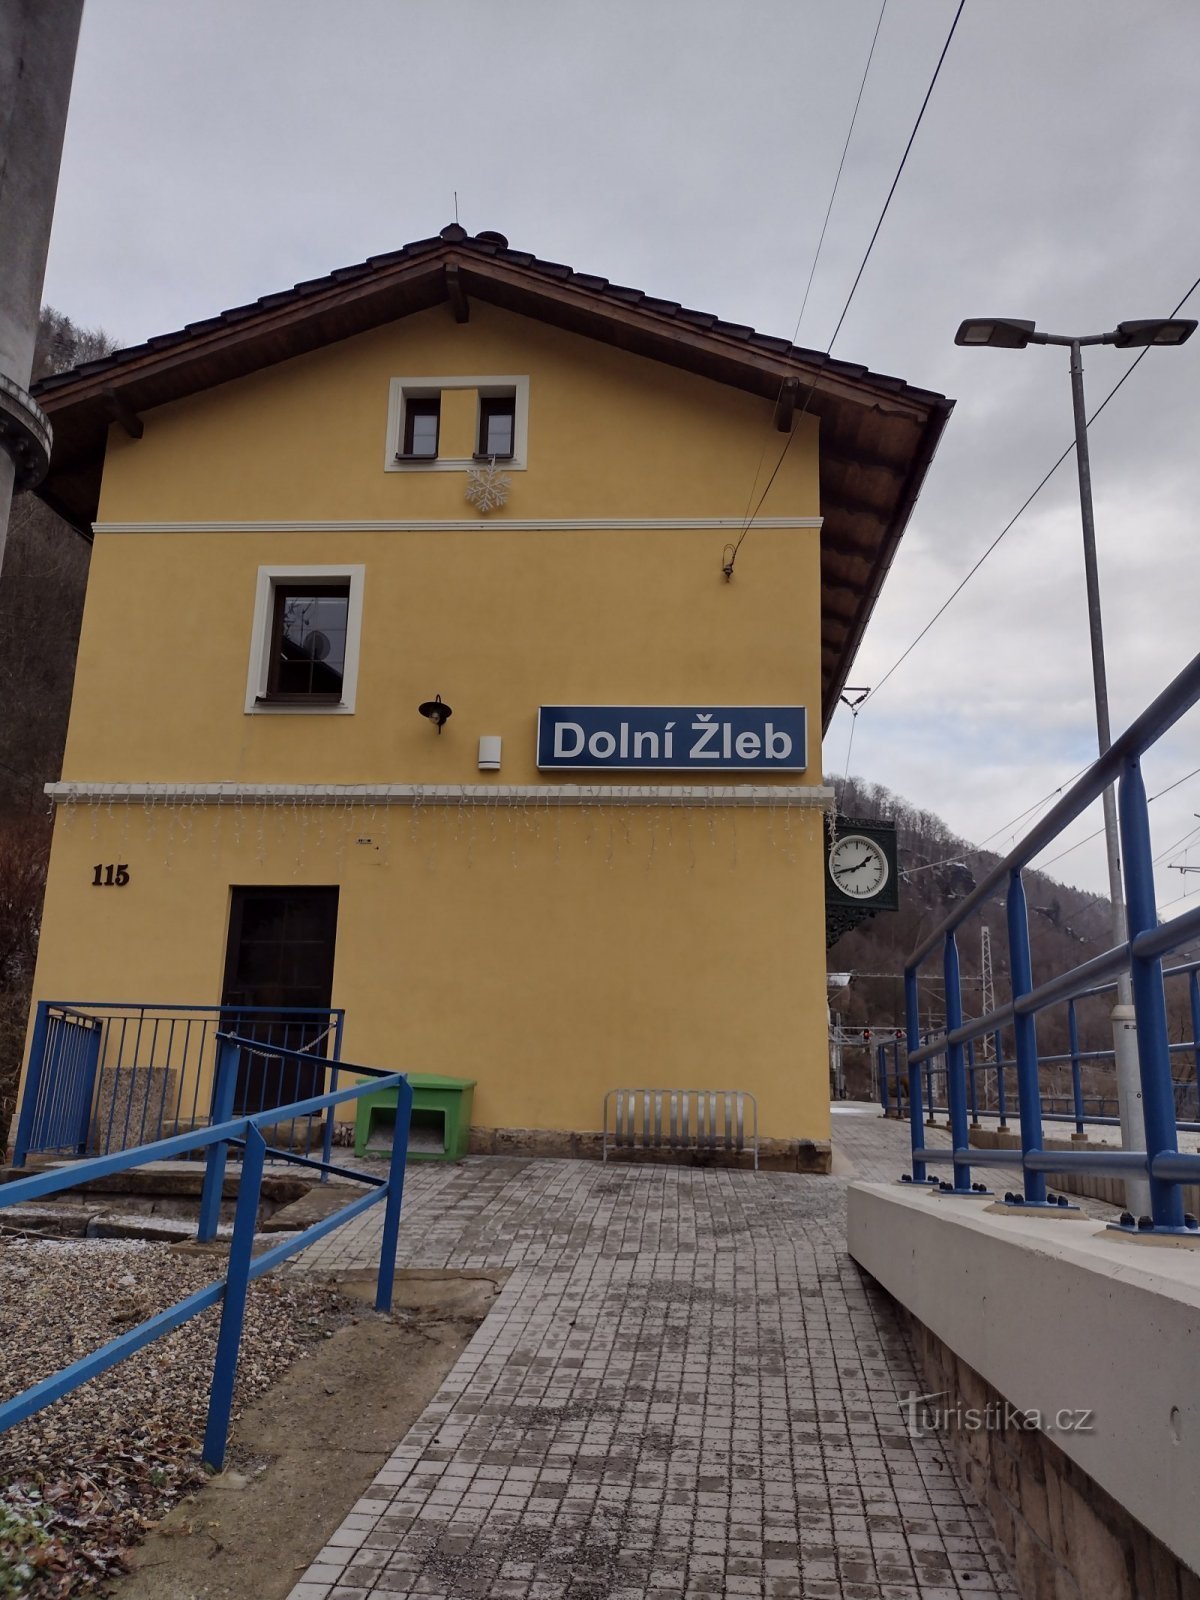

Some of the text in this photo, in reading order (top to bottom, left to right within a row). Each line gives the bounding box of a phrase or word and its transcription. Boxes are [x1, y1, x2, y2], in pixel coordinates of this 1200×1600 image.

[553, 713, 793, 759] Dolní Žleb
[92, 863, 130, 887] 115
